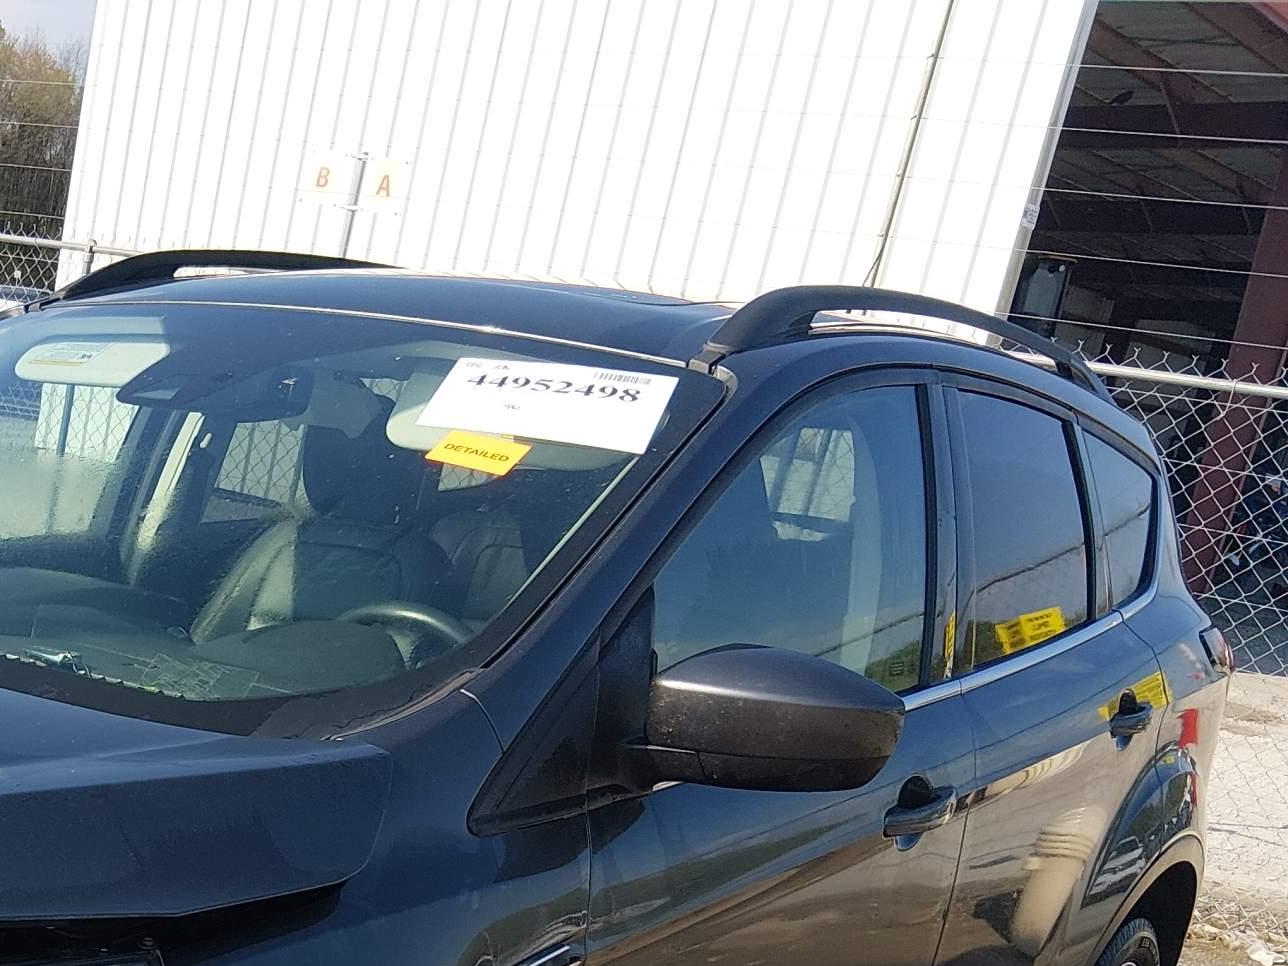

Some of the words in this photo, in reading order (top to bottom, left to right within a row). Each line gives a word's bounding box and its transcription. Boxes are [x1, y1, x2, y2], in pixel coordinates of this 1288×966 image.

[315, 166, 330, 188] B
[375, 174, 390, 197] A
[467, 374, 641, 403] 44952498
[444, 443, 510, 463] DETAILED
